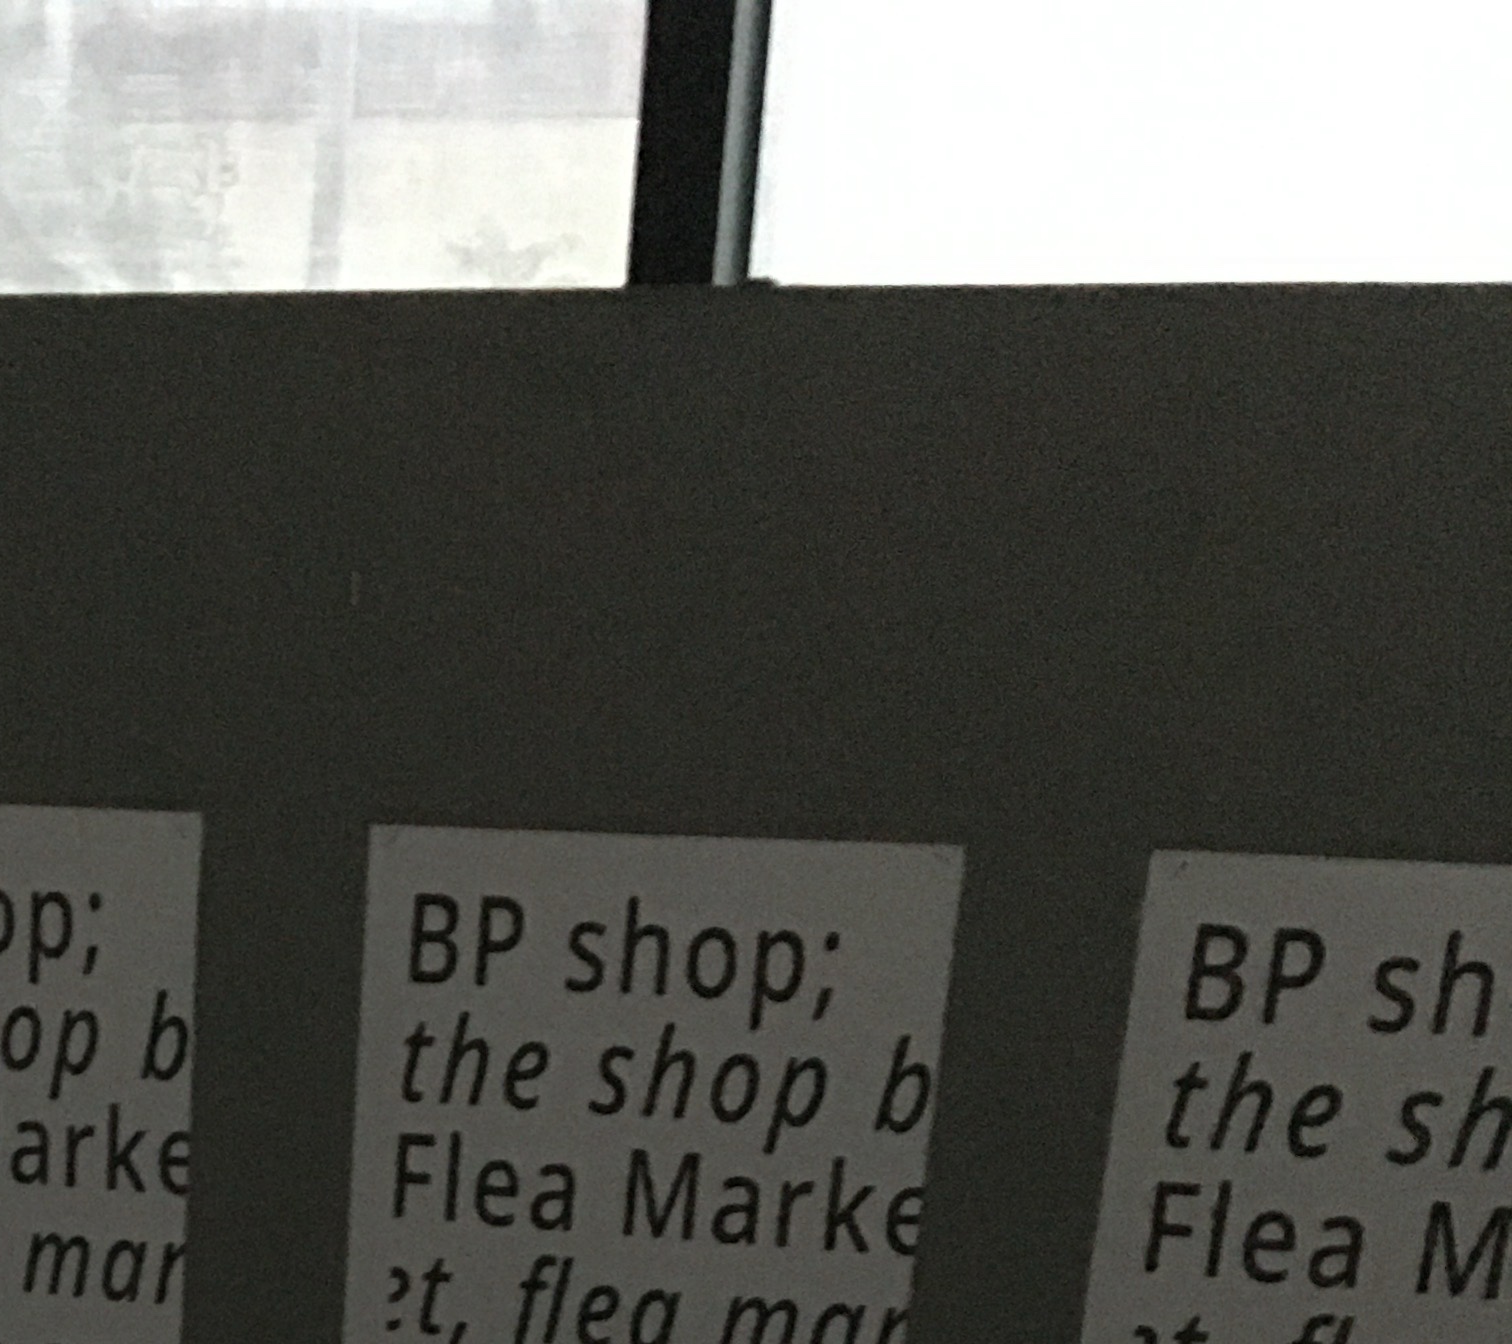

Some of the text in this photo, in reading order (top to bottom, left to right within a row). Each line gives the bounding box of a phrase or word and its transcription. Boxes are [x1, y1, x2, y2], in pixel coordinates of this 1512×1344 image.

[409, 893, 842, 1030] BP shop;
[1183, 923, 1496, 1037] BP sh
[142, 990, 188, 1081] b
[402, 1013, 932, 1155] the shop b
[1164, 1051, 1512, 1172] the sh
[392, 1132, 924, 1256] Flea Marke
[1143, 1180, 1365, 1289] Flea
[23, 1230, 187, 1304] mar
